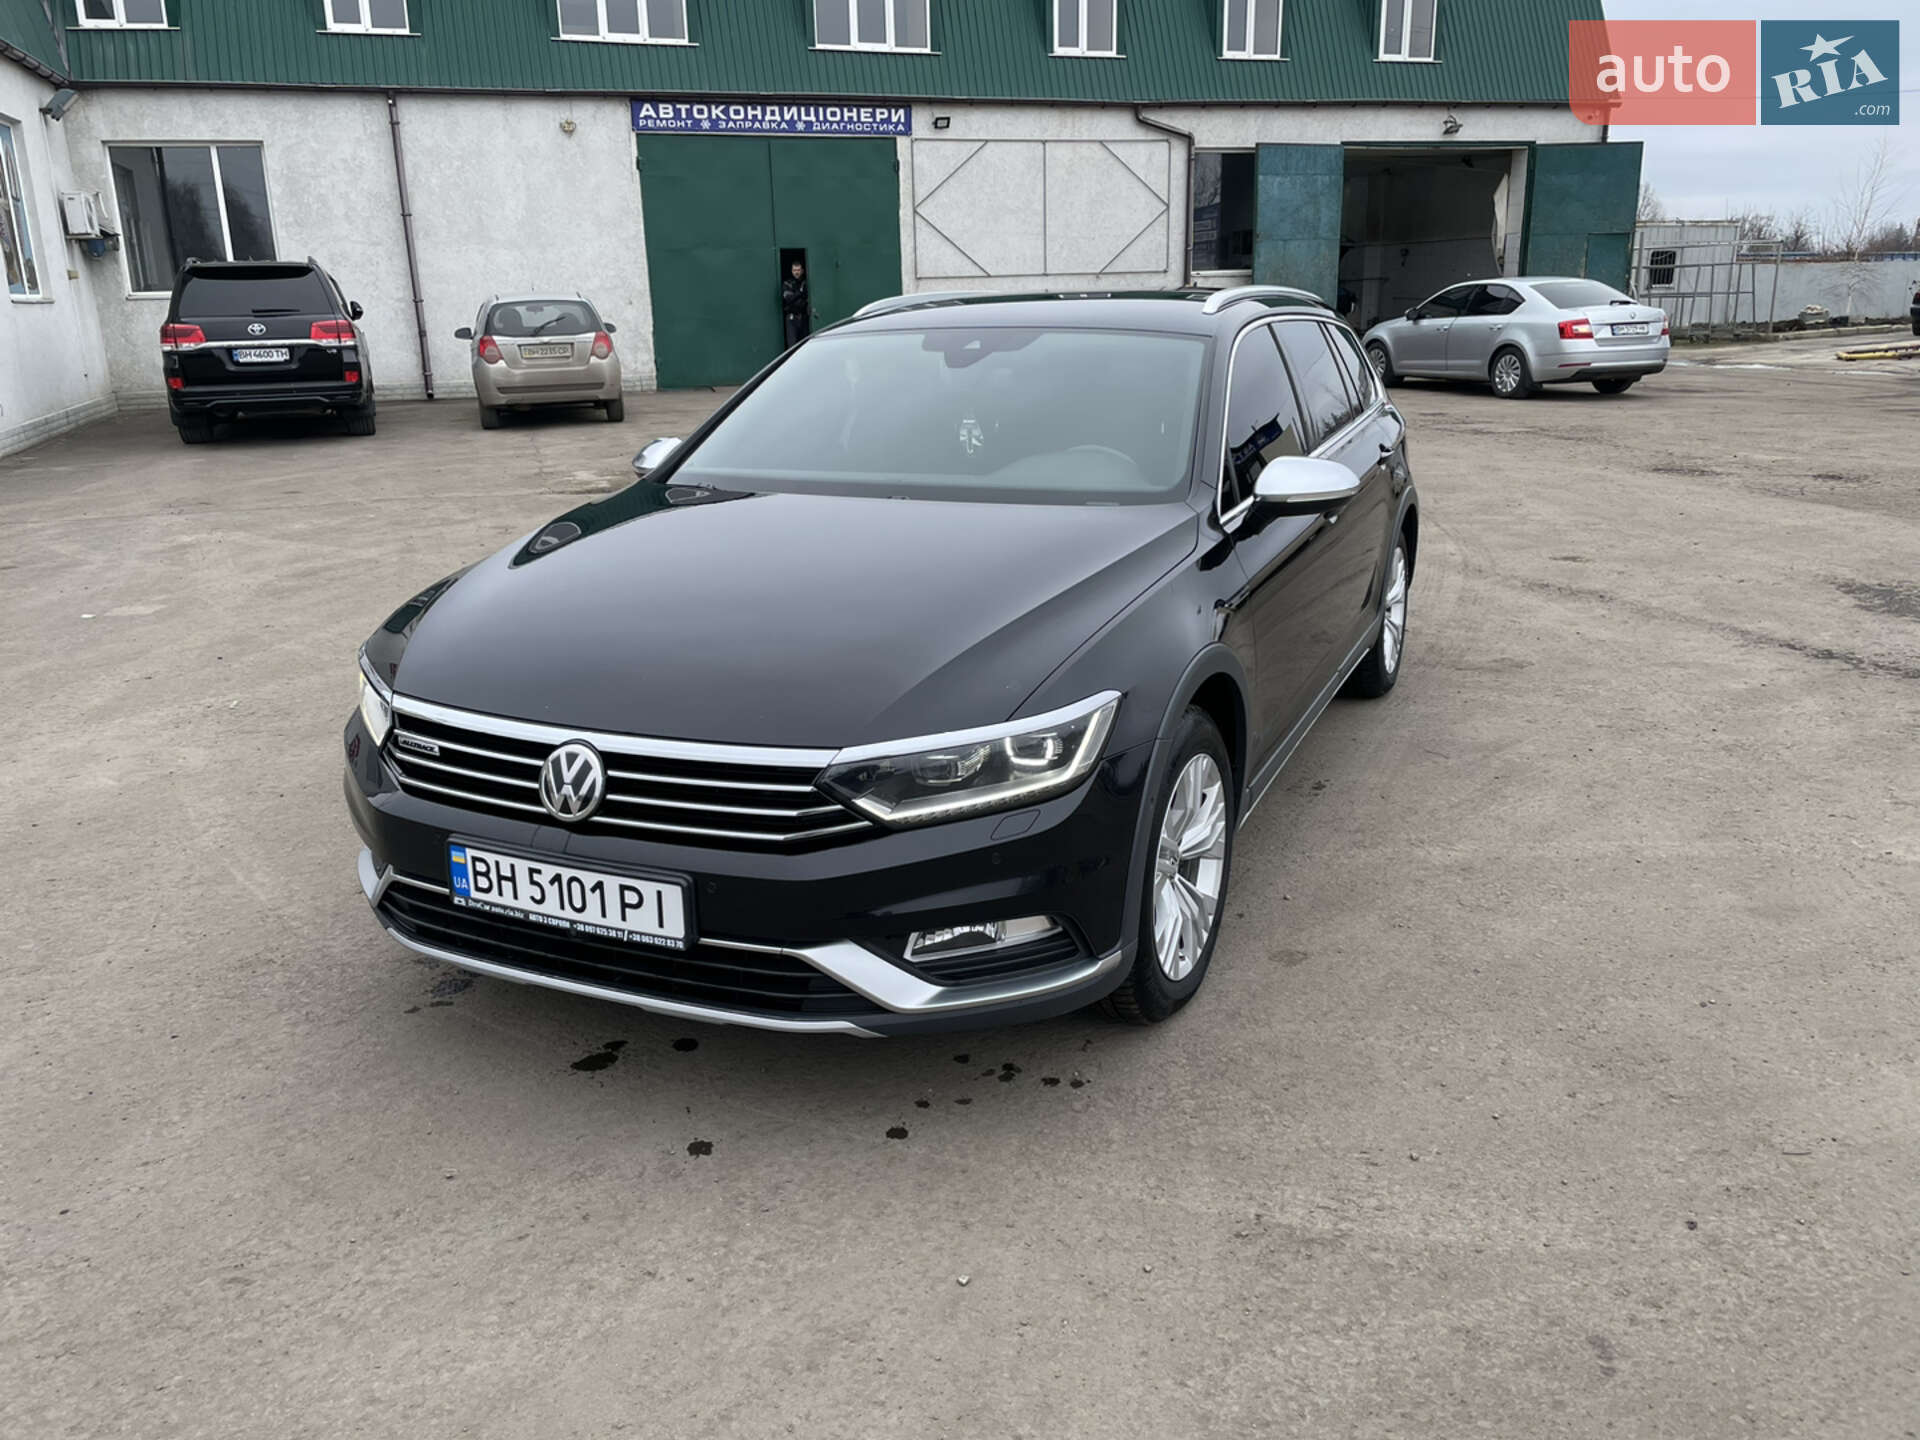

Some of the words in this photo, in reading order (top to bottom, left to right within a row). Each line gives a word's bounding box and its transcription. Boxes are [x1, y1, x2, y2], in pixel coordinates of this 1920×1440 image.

[639, 103, 905, 123] АВТОКОНДИЦІОНЕРИ
[639, 119, 693, 128] РЕМОНТ
[718, 120, 788, 129] ЗАПРАВКА
[812, 122, 905, 131] ДИАГНОСТИКА
[453, 876, 469, 889] UA
[471, 855, 518, 901] BH
[528, 866, 607, 919] 5101
